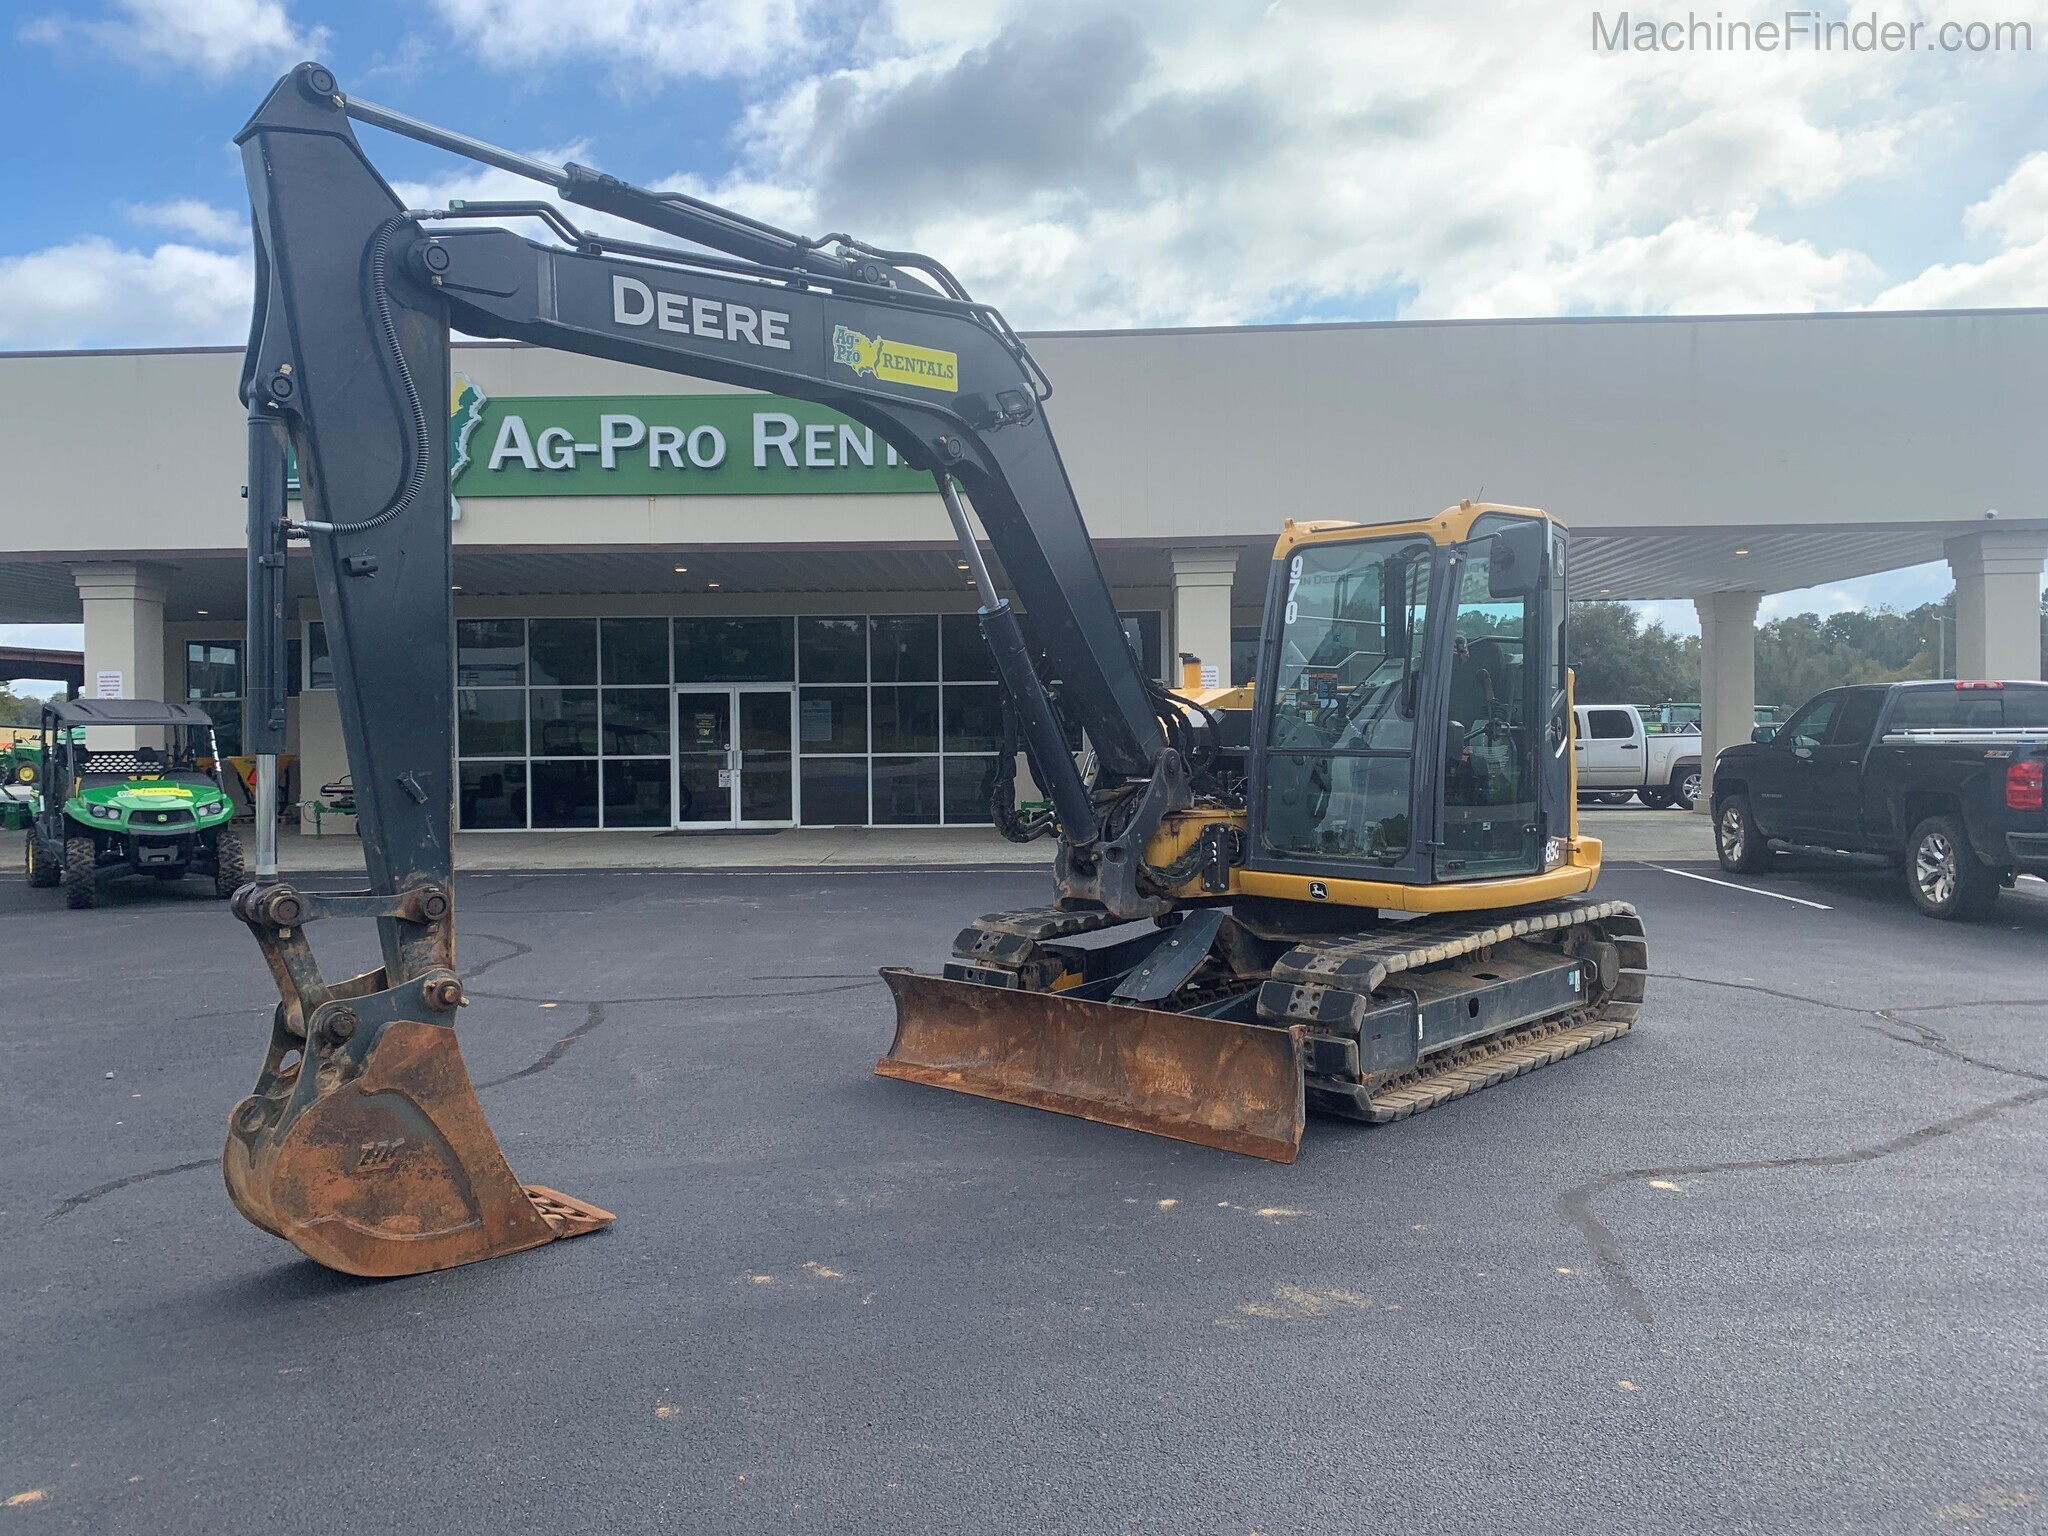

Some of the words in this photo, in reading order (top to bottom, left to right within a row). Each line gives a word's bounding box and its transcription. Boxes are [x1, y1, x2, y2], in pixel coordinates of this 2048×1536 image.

[612, 275, 791, 350] DEERE
[836, 345, 861, 363] Pro
[882, 352, 955, 379] RENTALS
